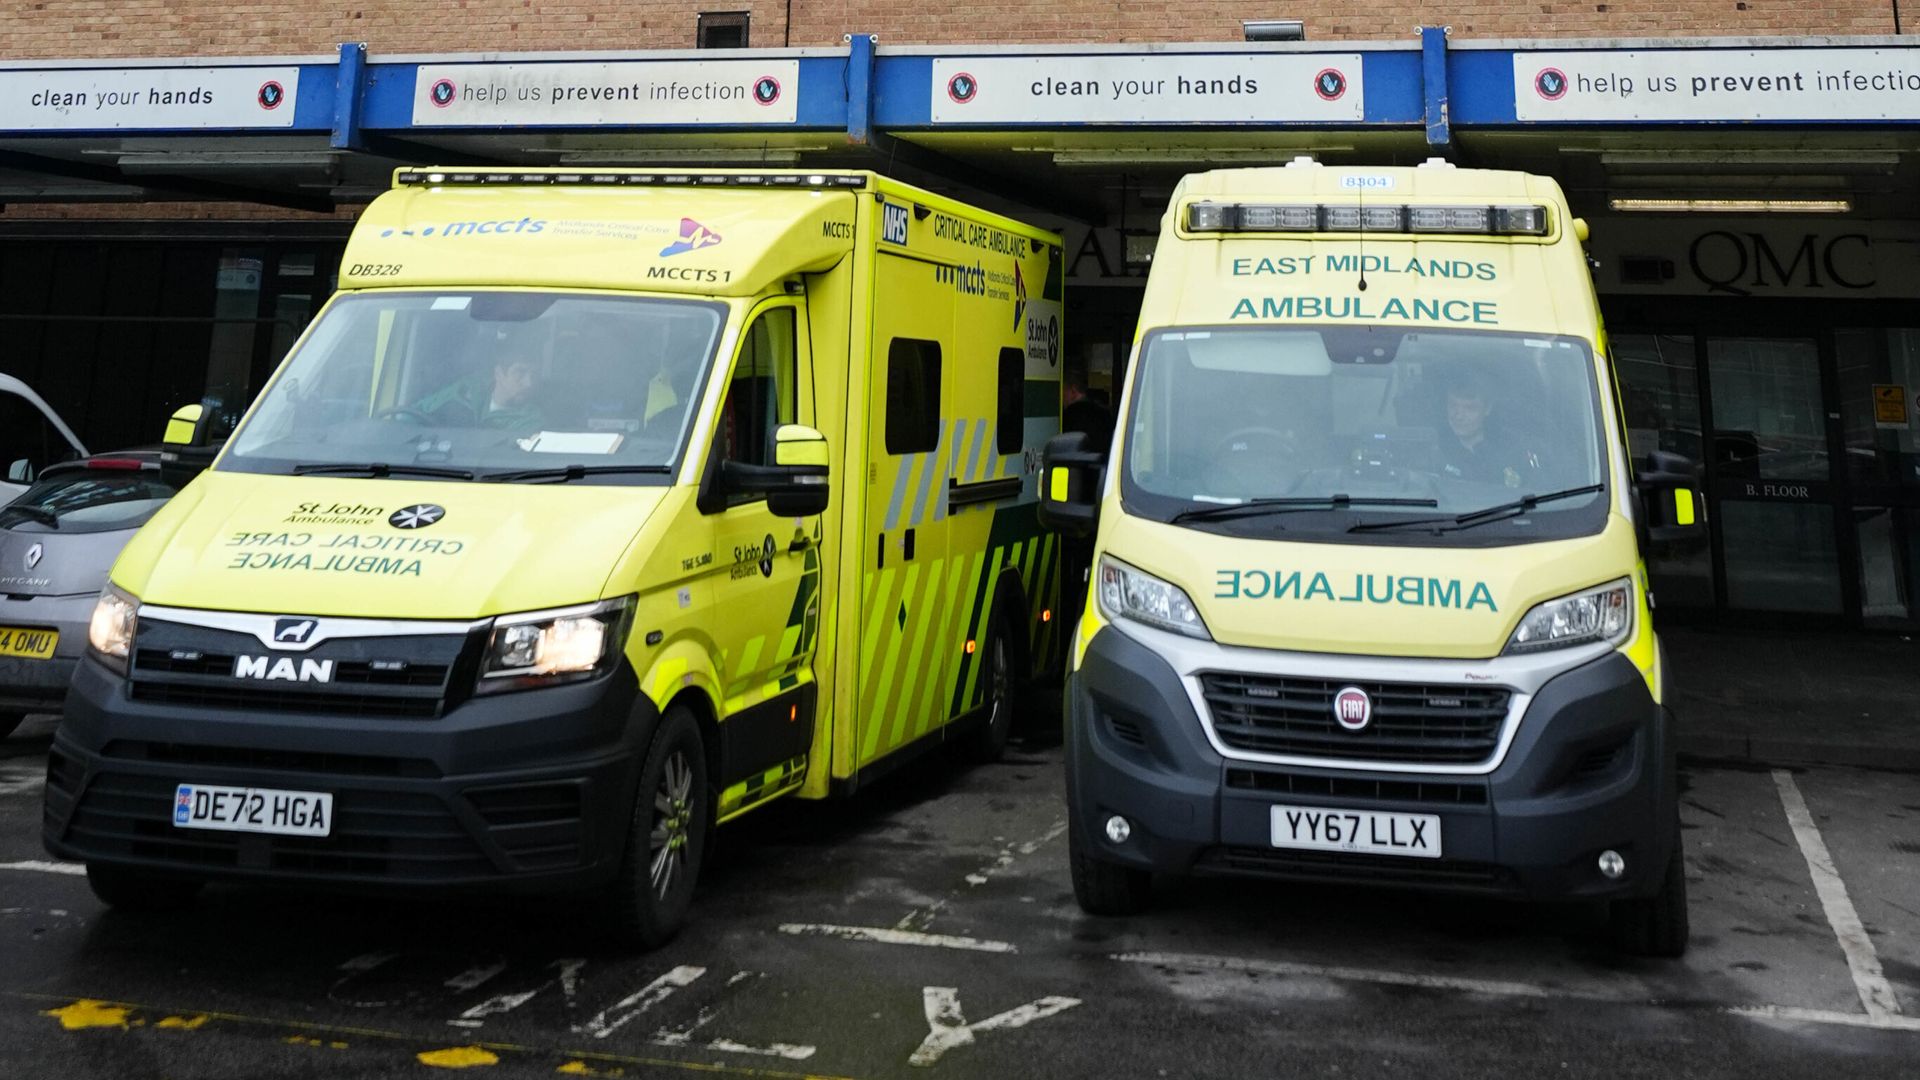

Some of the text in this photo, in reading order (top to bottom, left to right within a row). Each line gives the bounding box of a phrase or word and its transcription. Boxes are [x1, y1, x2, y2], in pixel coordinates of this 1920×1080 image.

[463, 83, 507, 104] help
[517, 86, 541, 101] us
[551, 82, 640, 104] prevent
[649, 81, 745, 100] infection
[1031, 75, 1258, 100] clean your hands
[1577, 73, 1634, 97] help
[1647, 76, 1677, 92] us
[1691, 71, 1804, 97] prevent
[1817, 70, 1920, 91] infectio
[31, 87, 213, 110] clean your hands
[1346, 177, 1387, 187] 8304
[442, 217, 547, 237] mccts
[822, 220, 850, 239] MCCTS
[884, 205, 907, 245] NHS
[934, 213, 1026, 260] CRITICAL CARE AMBULANCE
[348, 263, 403, 277] DB328
[646, 266, 732, 283] MCCTS 1
[1232, 255, 1497, 281] EAST MIDLANDS
[1689, 230, 1877, 297] QMC
[956, 259, 986, 297] mccts
[1229, 296, 1499, 325] AMBULANCE
[1035, 319, 1048, 342] John
[1746, 484, 1809, 498] B. FLOOR
[282, 514, 374, 525] Ambulance
[292, 502, 384, 516] St John
[744, 543, 761, 564] John
[14, 632, 52, 654] OMU
[235, 654, 334, 683] MAN
[1342, 699, 1364, 720] FIAT
[193, 790, 325, 829] DE72 HGA
[1286, 811, 1427, 849] YY67 LLX
